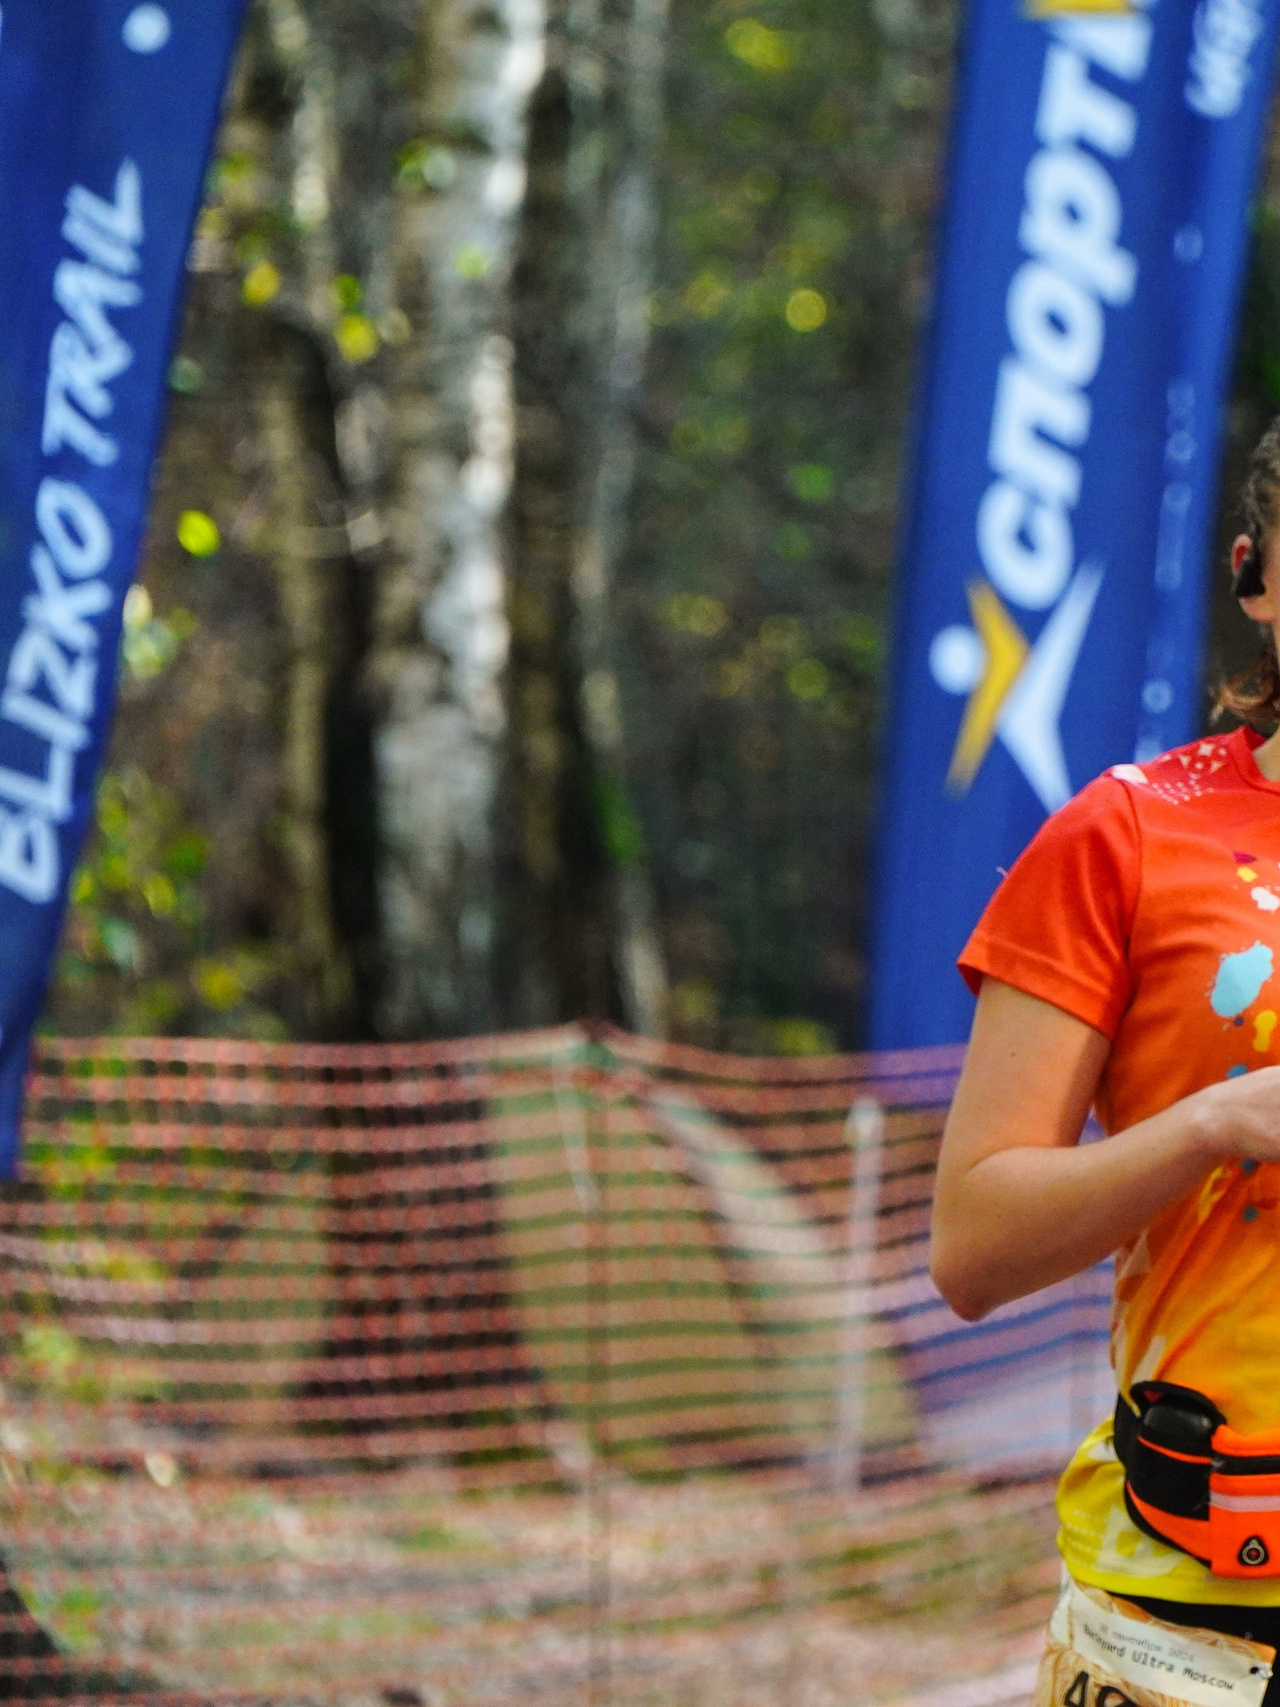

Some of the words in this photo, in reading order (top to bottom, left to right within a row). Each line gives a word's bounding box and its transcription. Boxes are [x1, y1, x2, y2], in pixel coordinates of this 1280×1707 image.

[42, 157, 143, 468] TRAIL
[0, 476, 112, 906] BLIZKO
[1132, 1650, 1175, 1674] Ultra
[1181, 1666, 1236, 1691] Moscow
